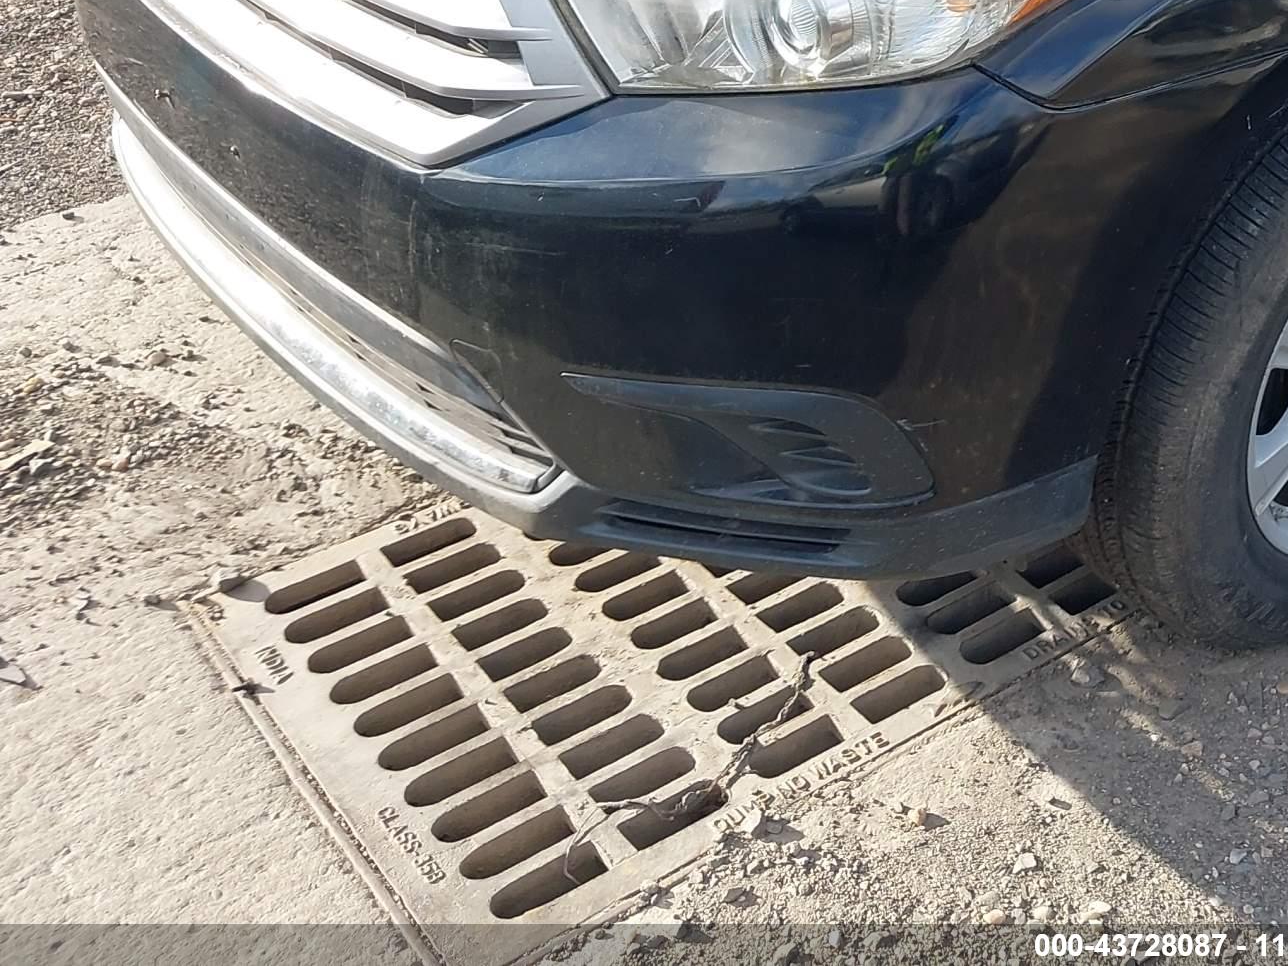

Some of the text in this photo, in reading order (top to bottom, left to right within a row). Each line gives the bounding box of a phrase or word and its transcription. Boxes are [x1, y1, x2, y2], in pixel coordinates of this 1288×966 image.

[713, 731, 891, 833] DUMP NO WASTE
